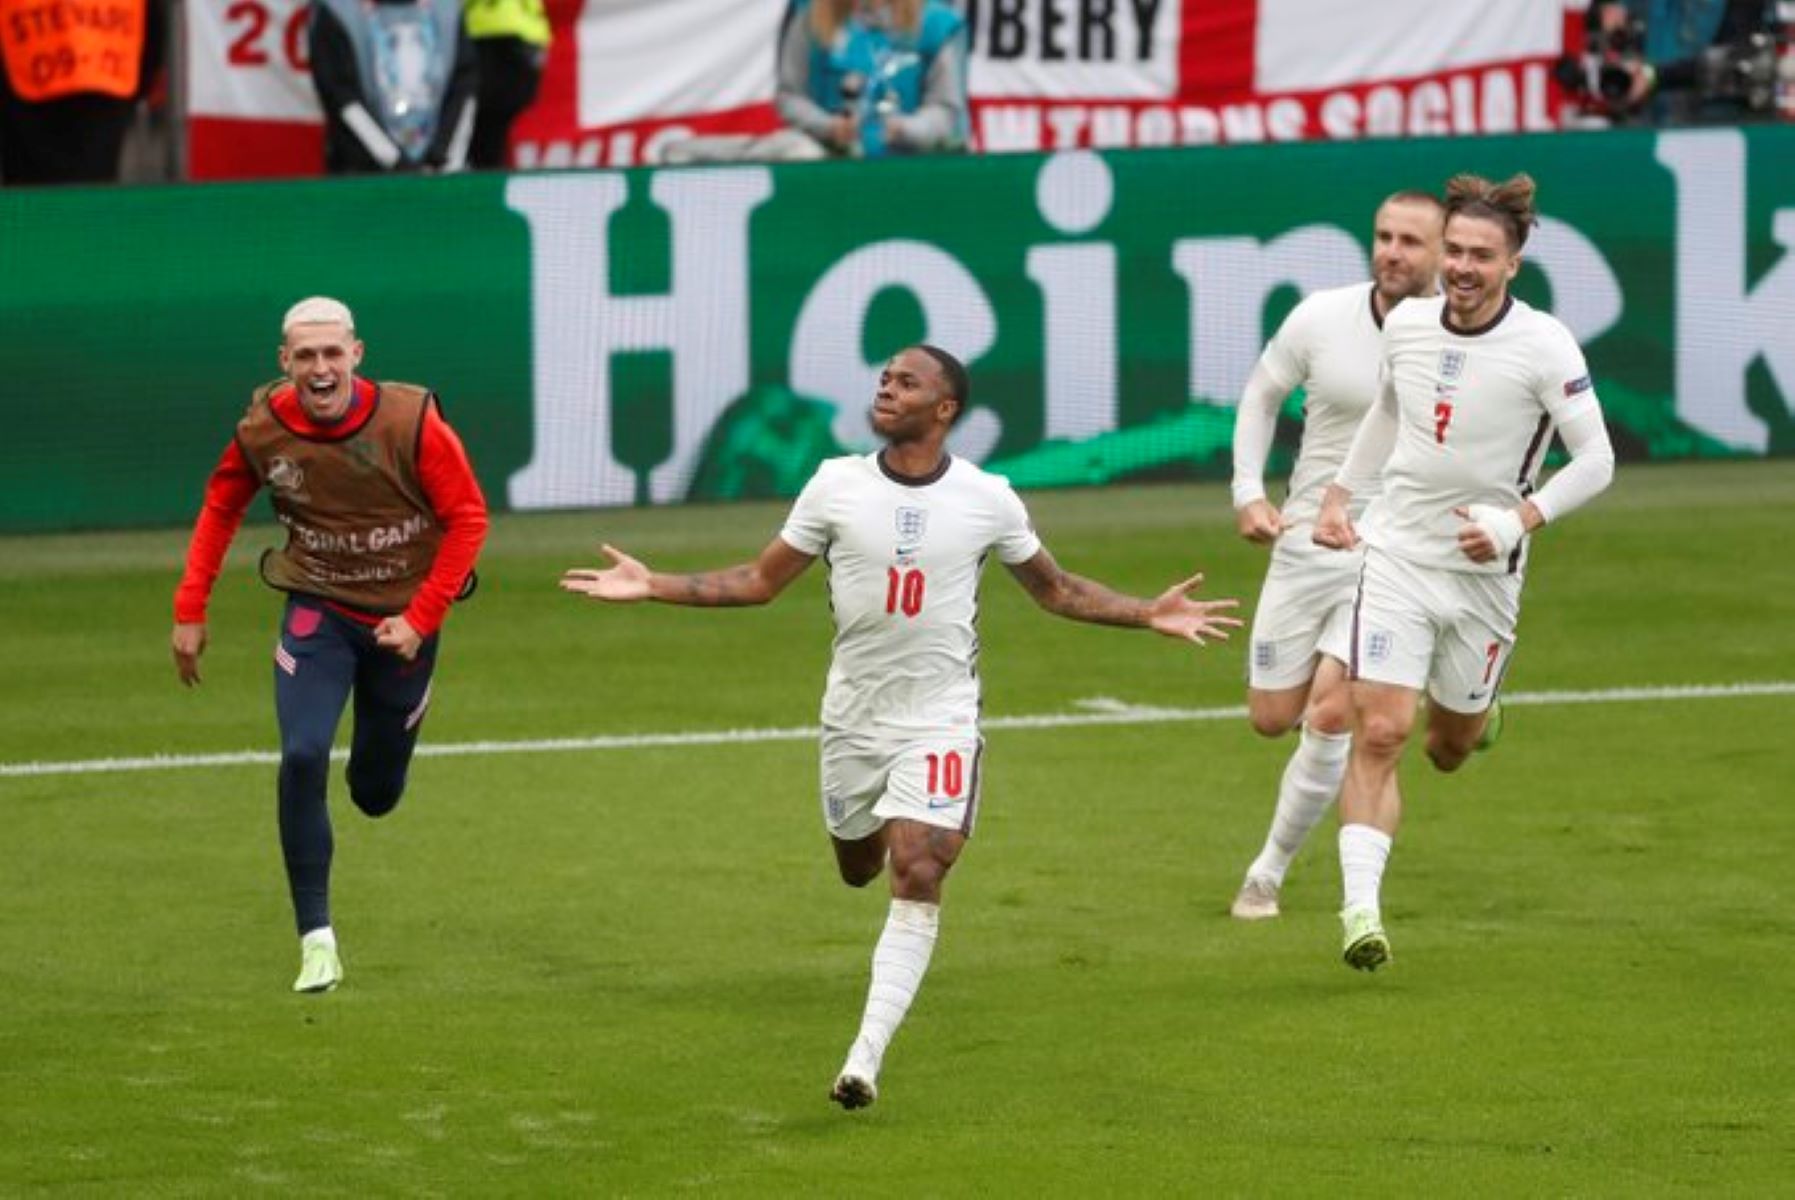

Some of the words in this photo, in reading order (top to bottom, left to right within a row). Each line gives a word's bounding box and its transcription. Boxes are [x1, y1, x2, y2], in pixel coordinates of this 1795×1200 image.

[966, 0, 1162, 61] BERY
[1434, 401, 1453, 444] 7
[886, 566, 926, 617] 10
[1485, 642, 1499, 684] 7
[926, 750, 962, 798] 10
